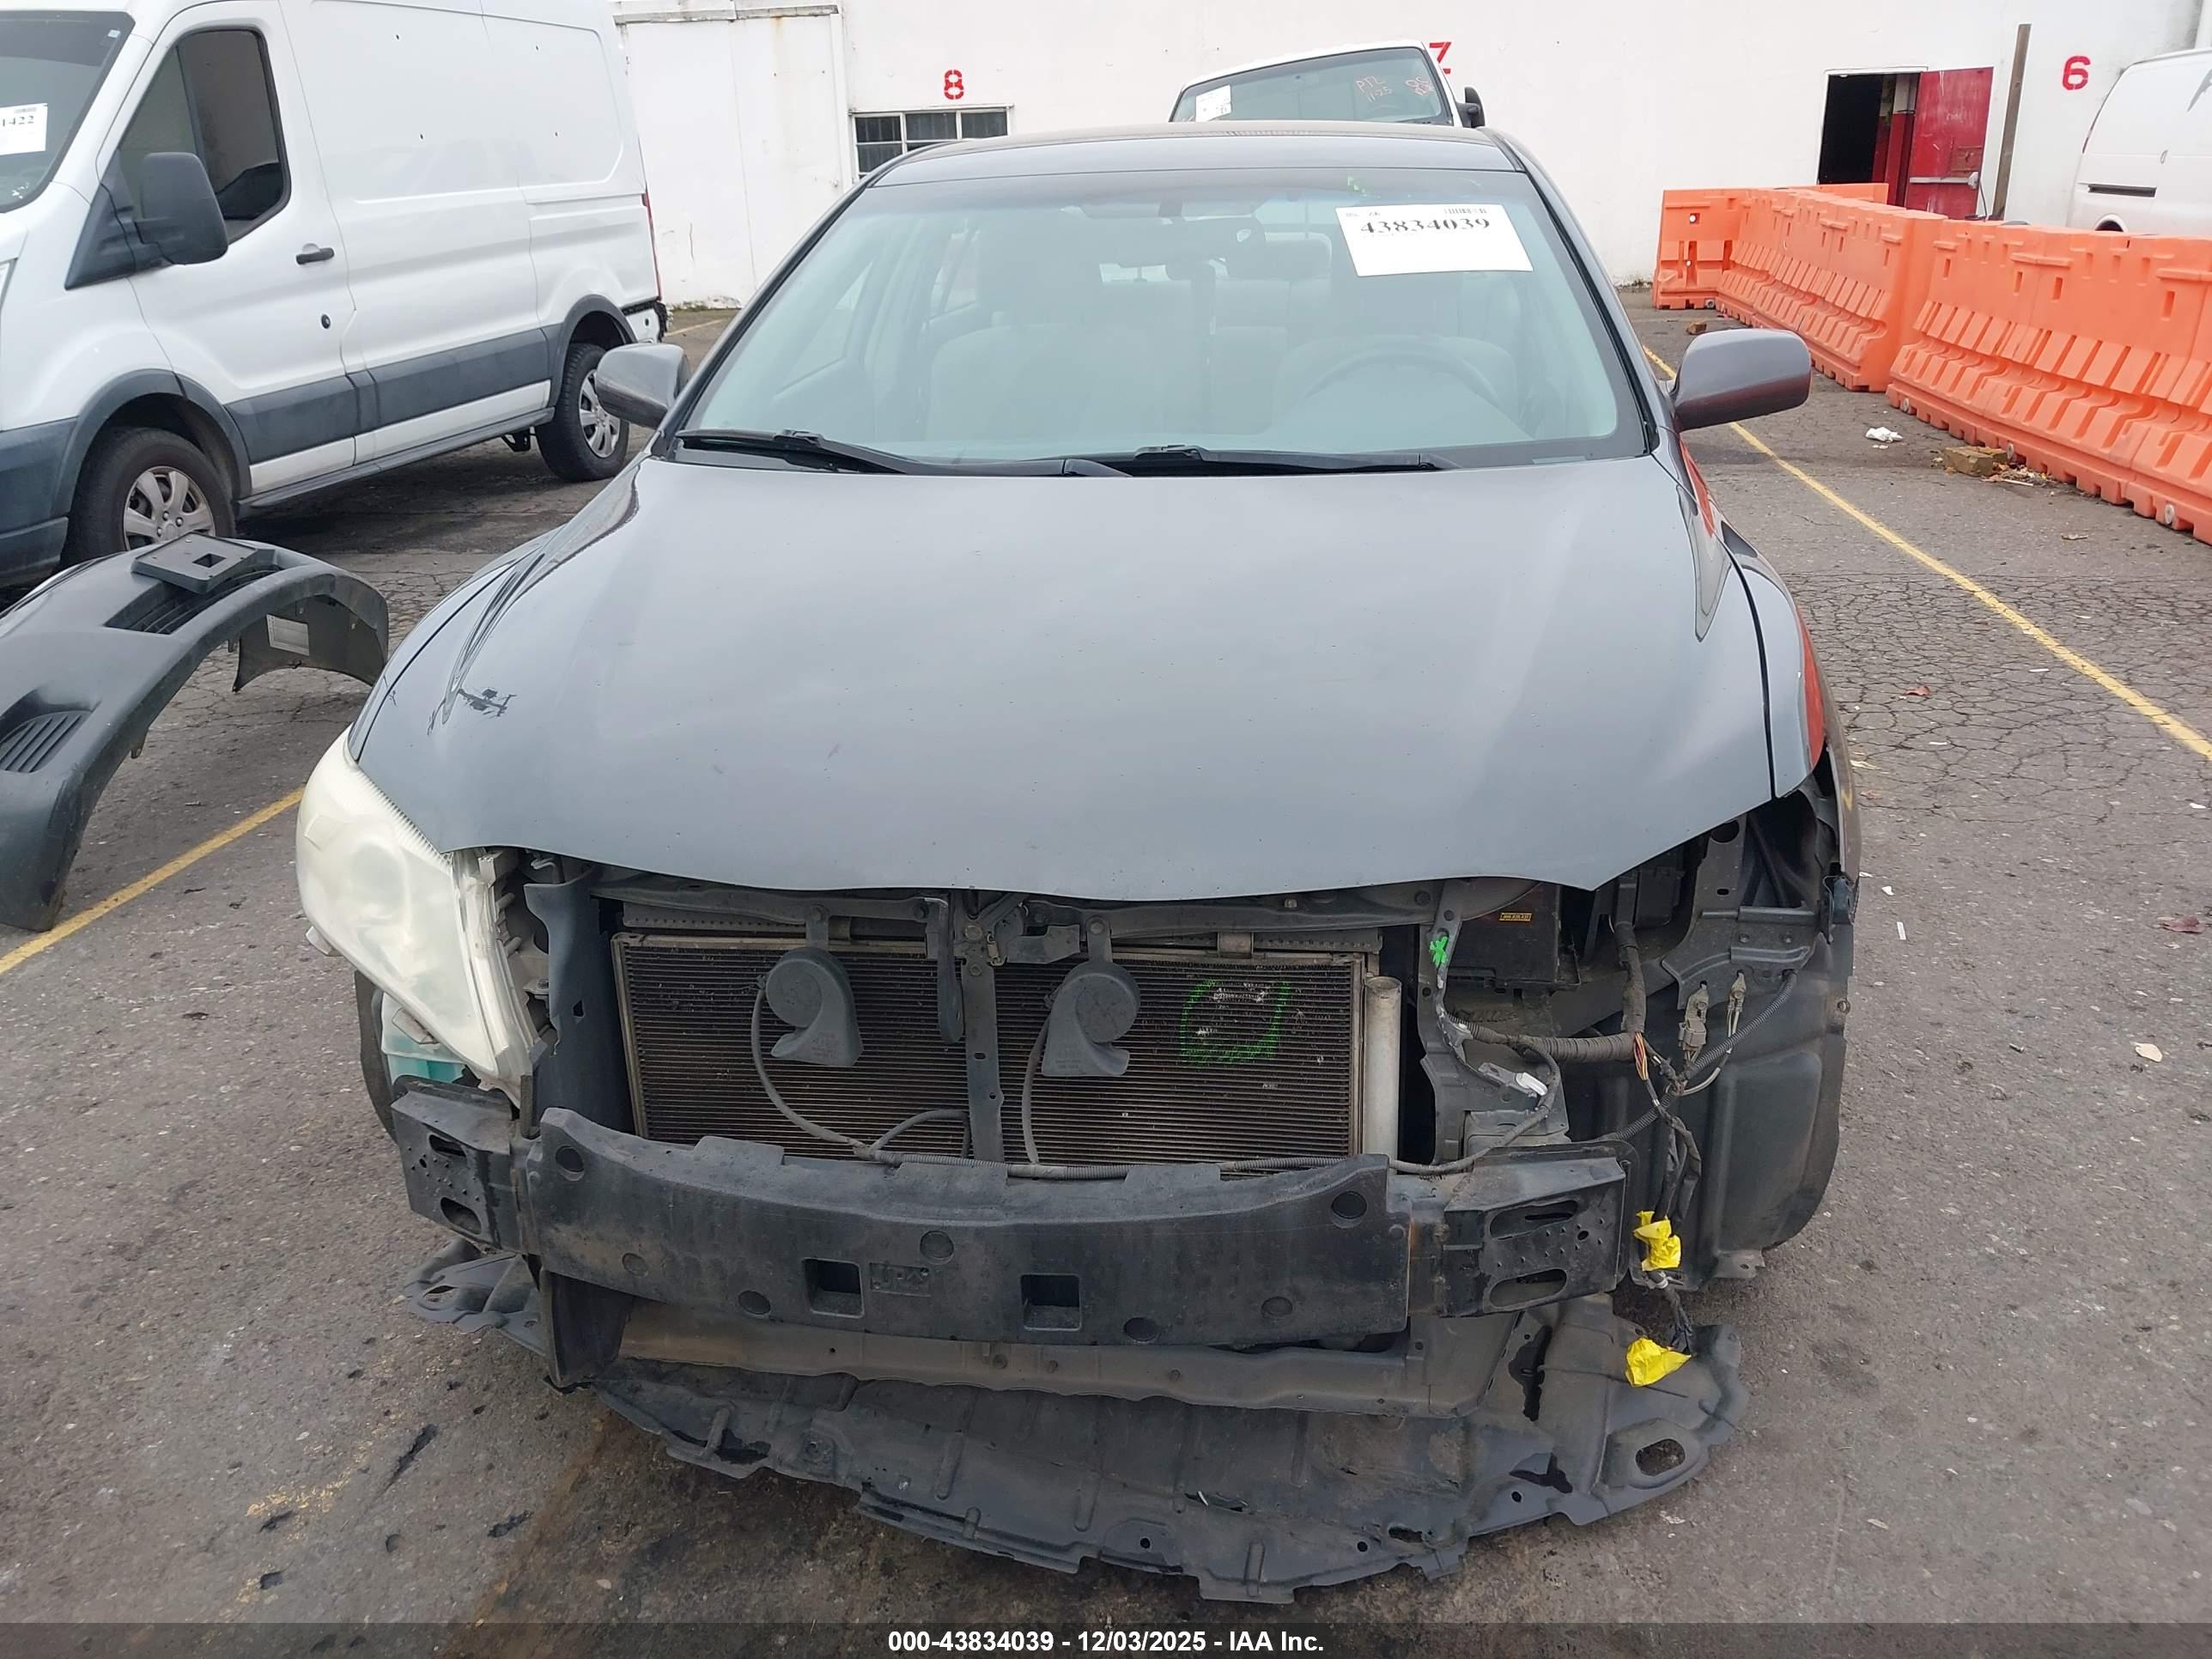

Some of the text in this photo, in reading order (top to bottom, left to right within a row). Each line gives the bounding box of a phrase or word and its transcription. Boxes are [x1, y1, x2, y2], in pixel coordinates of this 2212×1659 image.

[944, 69, 964, 100] 8
[2062, 55, 2091, 91] 6
[1360, 218, 1490, 234] 43834039
